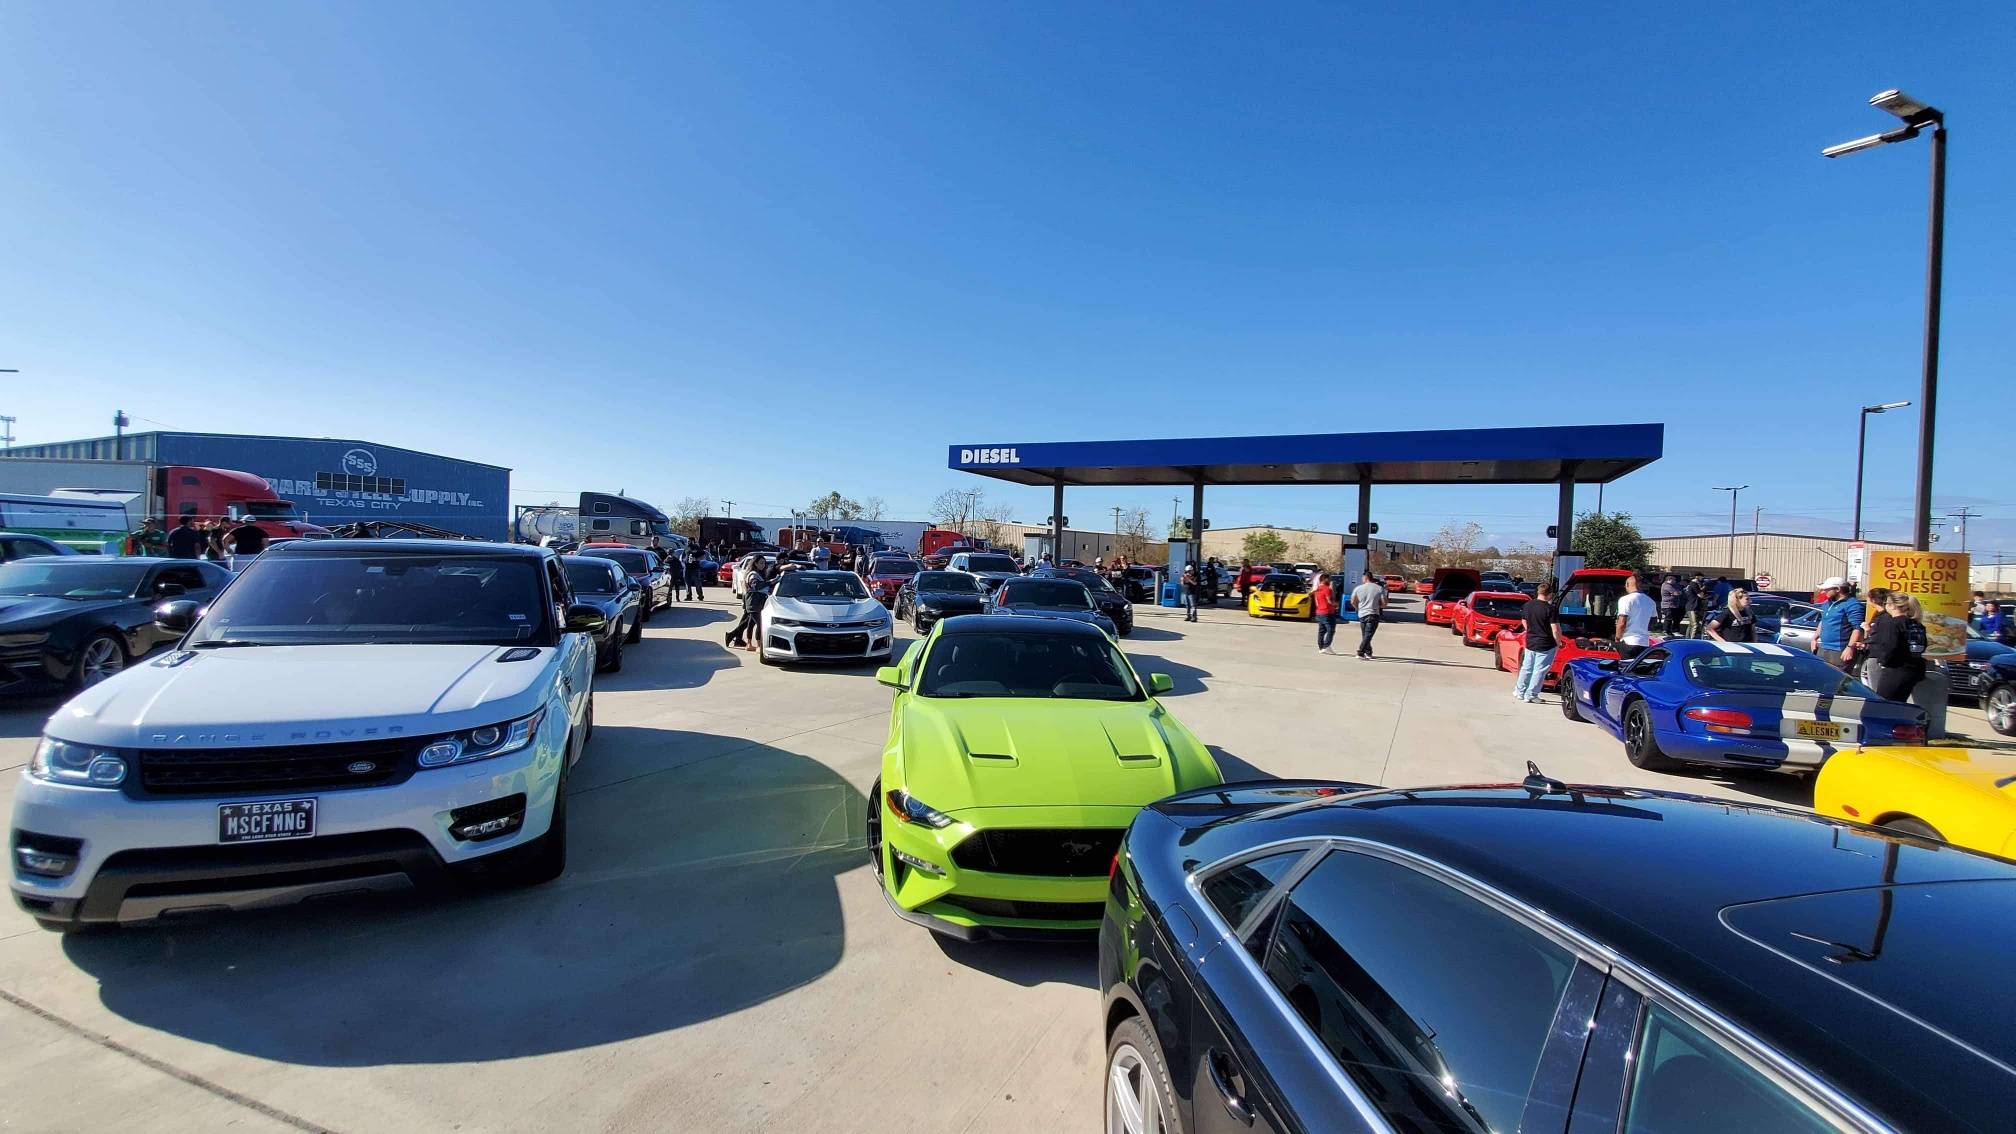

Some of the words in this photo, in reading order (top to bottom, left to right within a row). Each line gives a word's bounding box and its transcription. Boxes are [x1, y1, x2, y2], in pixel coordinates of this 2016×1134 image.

[961, 448, 1020, 464] DIESEL
[316, 497, 365, 508] TEXAS
[371, 501, 402, 510] CITY
[1884, 557, 1922, 569] BUY
[1928, 558, 1959, 570] 100
[1884, 569, 1957, 582] GALLON
[1889, 581, 1951, 594] DIESEL
[153, 734, 266, 744] RANGE
[291, 726, 404, 740] ROVER
[242, 802, 293, 814] TEXAS
